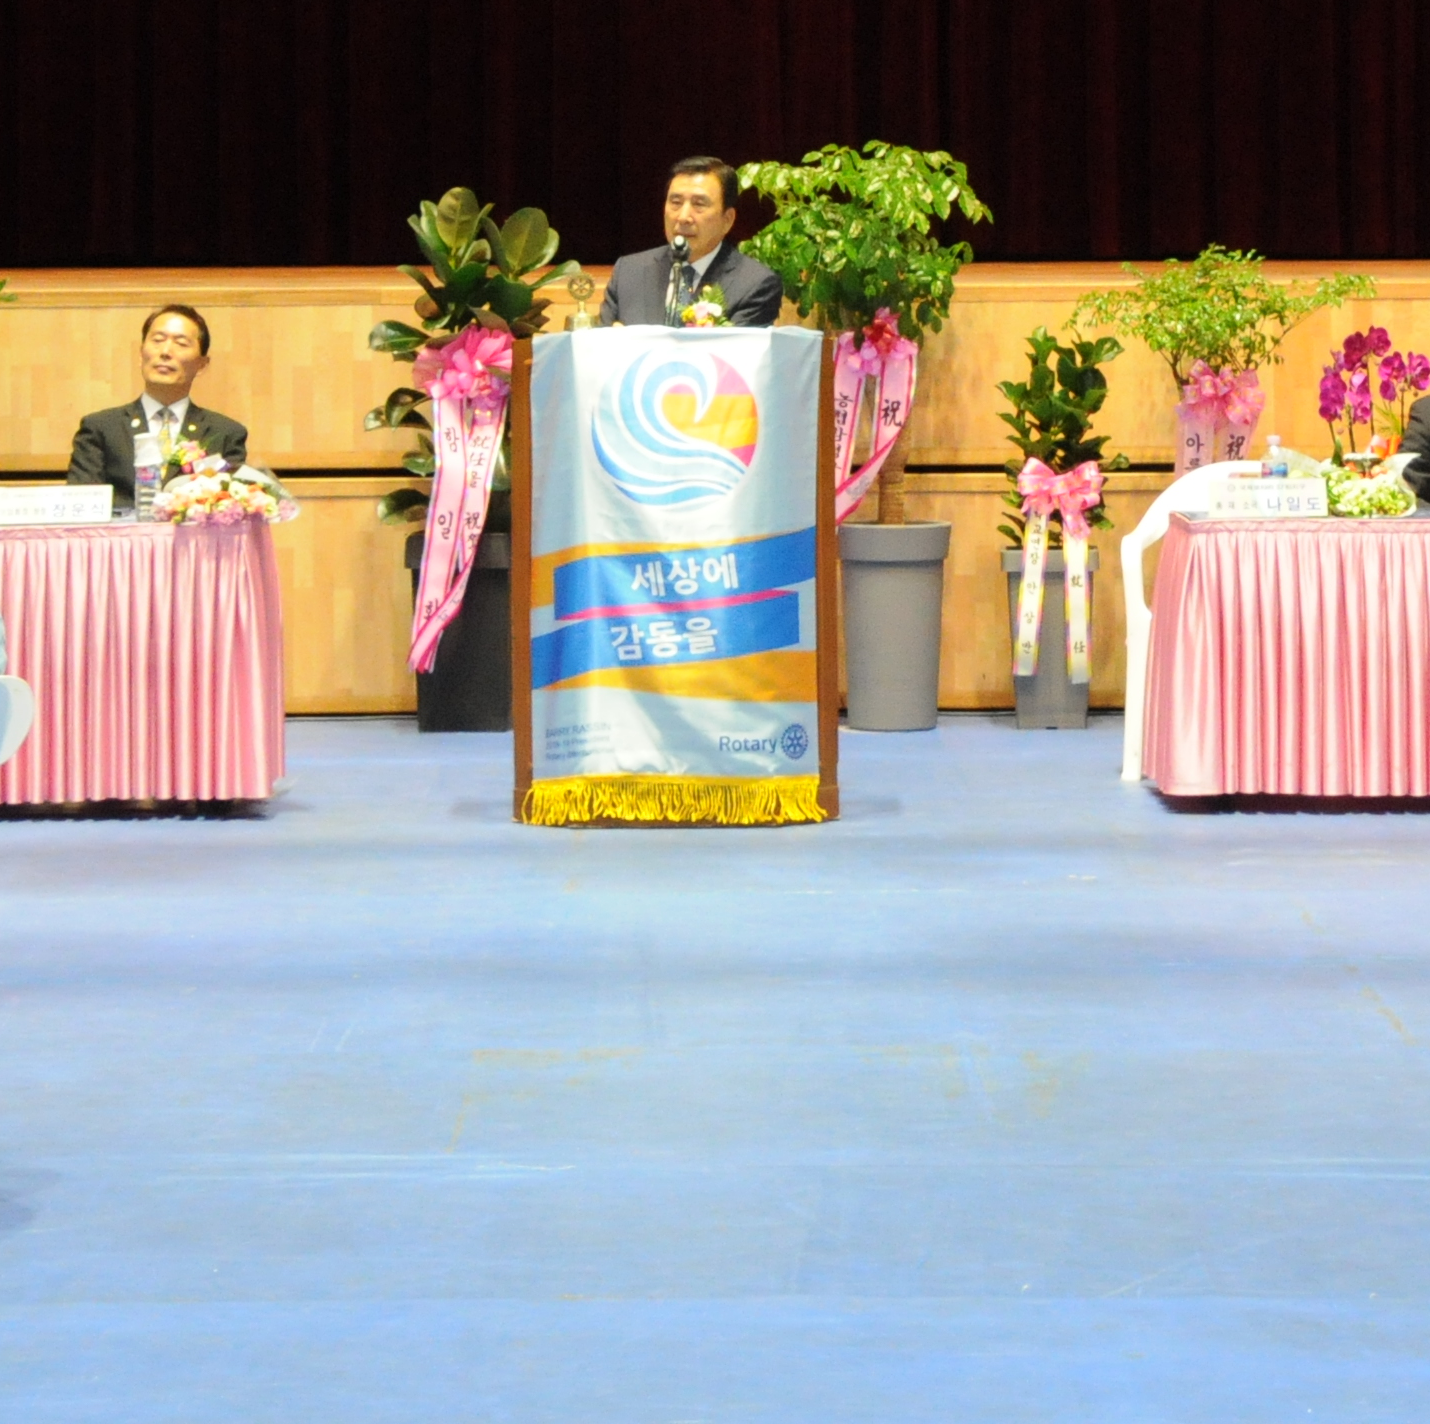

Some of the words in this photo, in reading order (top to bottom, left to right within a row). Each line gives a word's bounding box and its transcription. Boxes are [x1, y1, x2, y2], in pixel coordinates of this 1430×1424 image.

[881, 398, 903, 427] 祝
[1267, 496, 1321, 512] 나일도
[630, 552, 739, 597] 세상에
[608, 618, 719, 662] 감동을
[718, 736, 778, 754] Rotary
